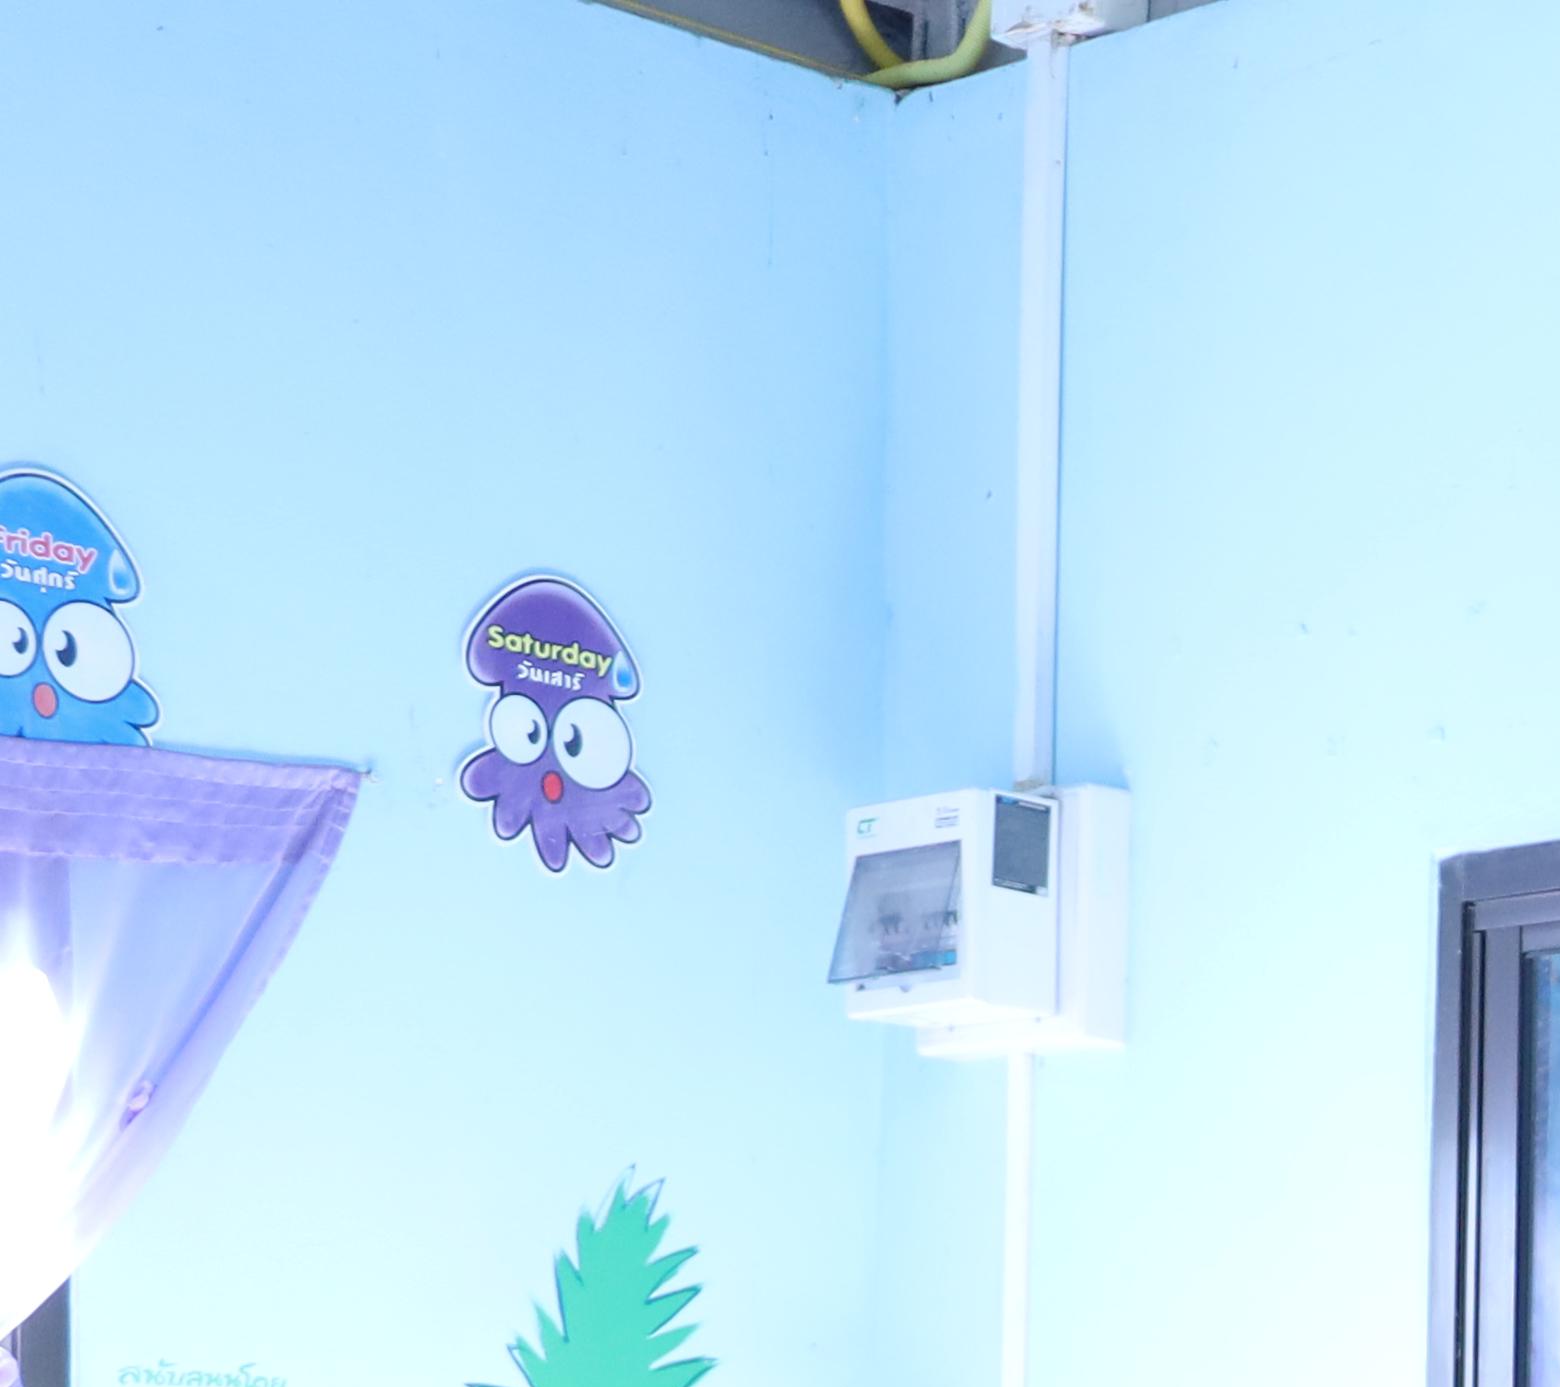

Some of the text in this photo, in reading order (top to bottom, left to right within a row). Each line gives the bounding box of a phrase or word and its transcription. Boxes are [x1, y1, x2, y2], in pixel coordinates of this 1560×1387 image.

[1, 558, 80, 593] วันศุกร์
[487, 624, 612, 677] Saturday
[517, 660, 585, 690] วันเสาร์
